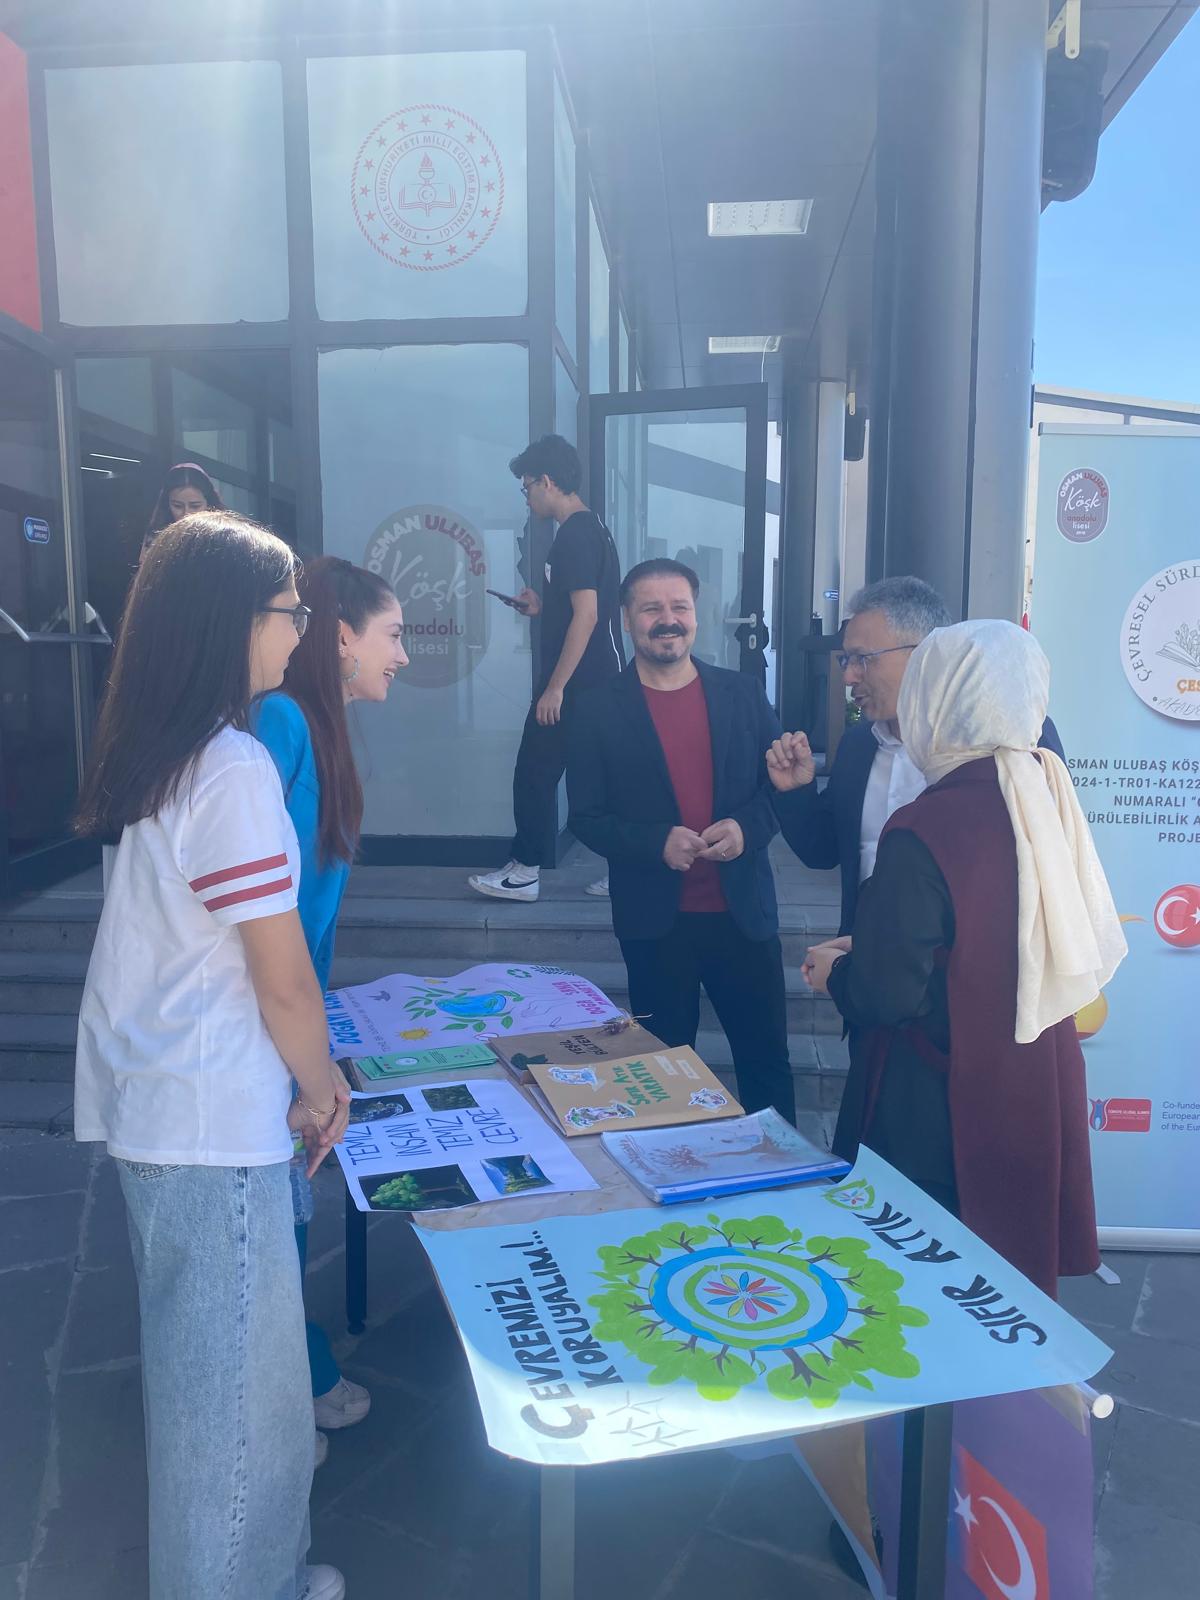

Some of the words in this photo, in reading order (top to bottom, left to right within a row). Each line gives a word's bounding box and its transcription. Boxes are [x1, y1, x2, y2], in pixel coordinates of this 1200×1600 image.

[1060, 472, 1083, 498] OSMAN
[1064, 486, 1101, 512] Köşk
[367, 514, 422, 574] OSMAN
[424, 514, 486, 577] ULUBAŞ
[390, 550, 473, 612] Köşk
[402, 617, 465, 636] nadolu
[1128, 593, 1156, 683] ÇEVRESEL
[1113, 759, 1167, 773] ULUBAŞ
[1114, 795, 1186, 807] NUMARALI
[626, 1060, 671, 1102] YARATIK
[465, 1107, 523, 1145] ÇEVRE
[1161, 1122, 1170, 1130] of
[1171, 1122, 1185, 1131] the
[852, 1201, 962, 1263] ATIK
[941, 1273, 1048, 1346] SIFIR
[474, 1277, 596, 1440] ÇEVREMİZİ
